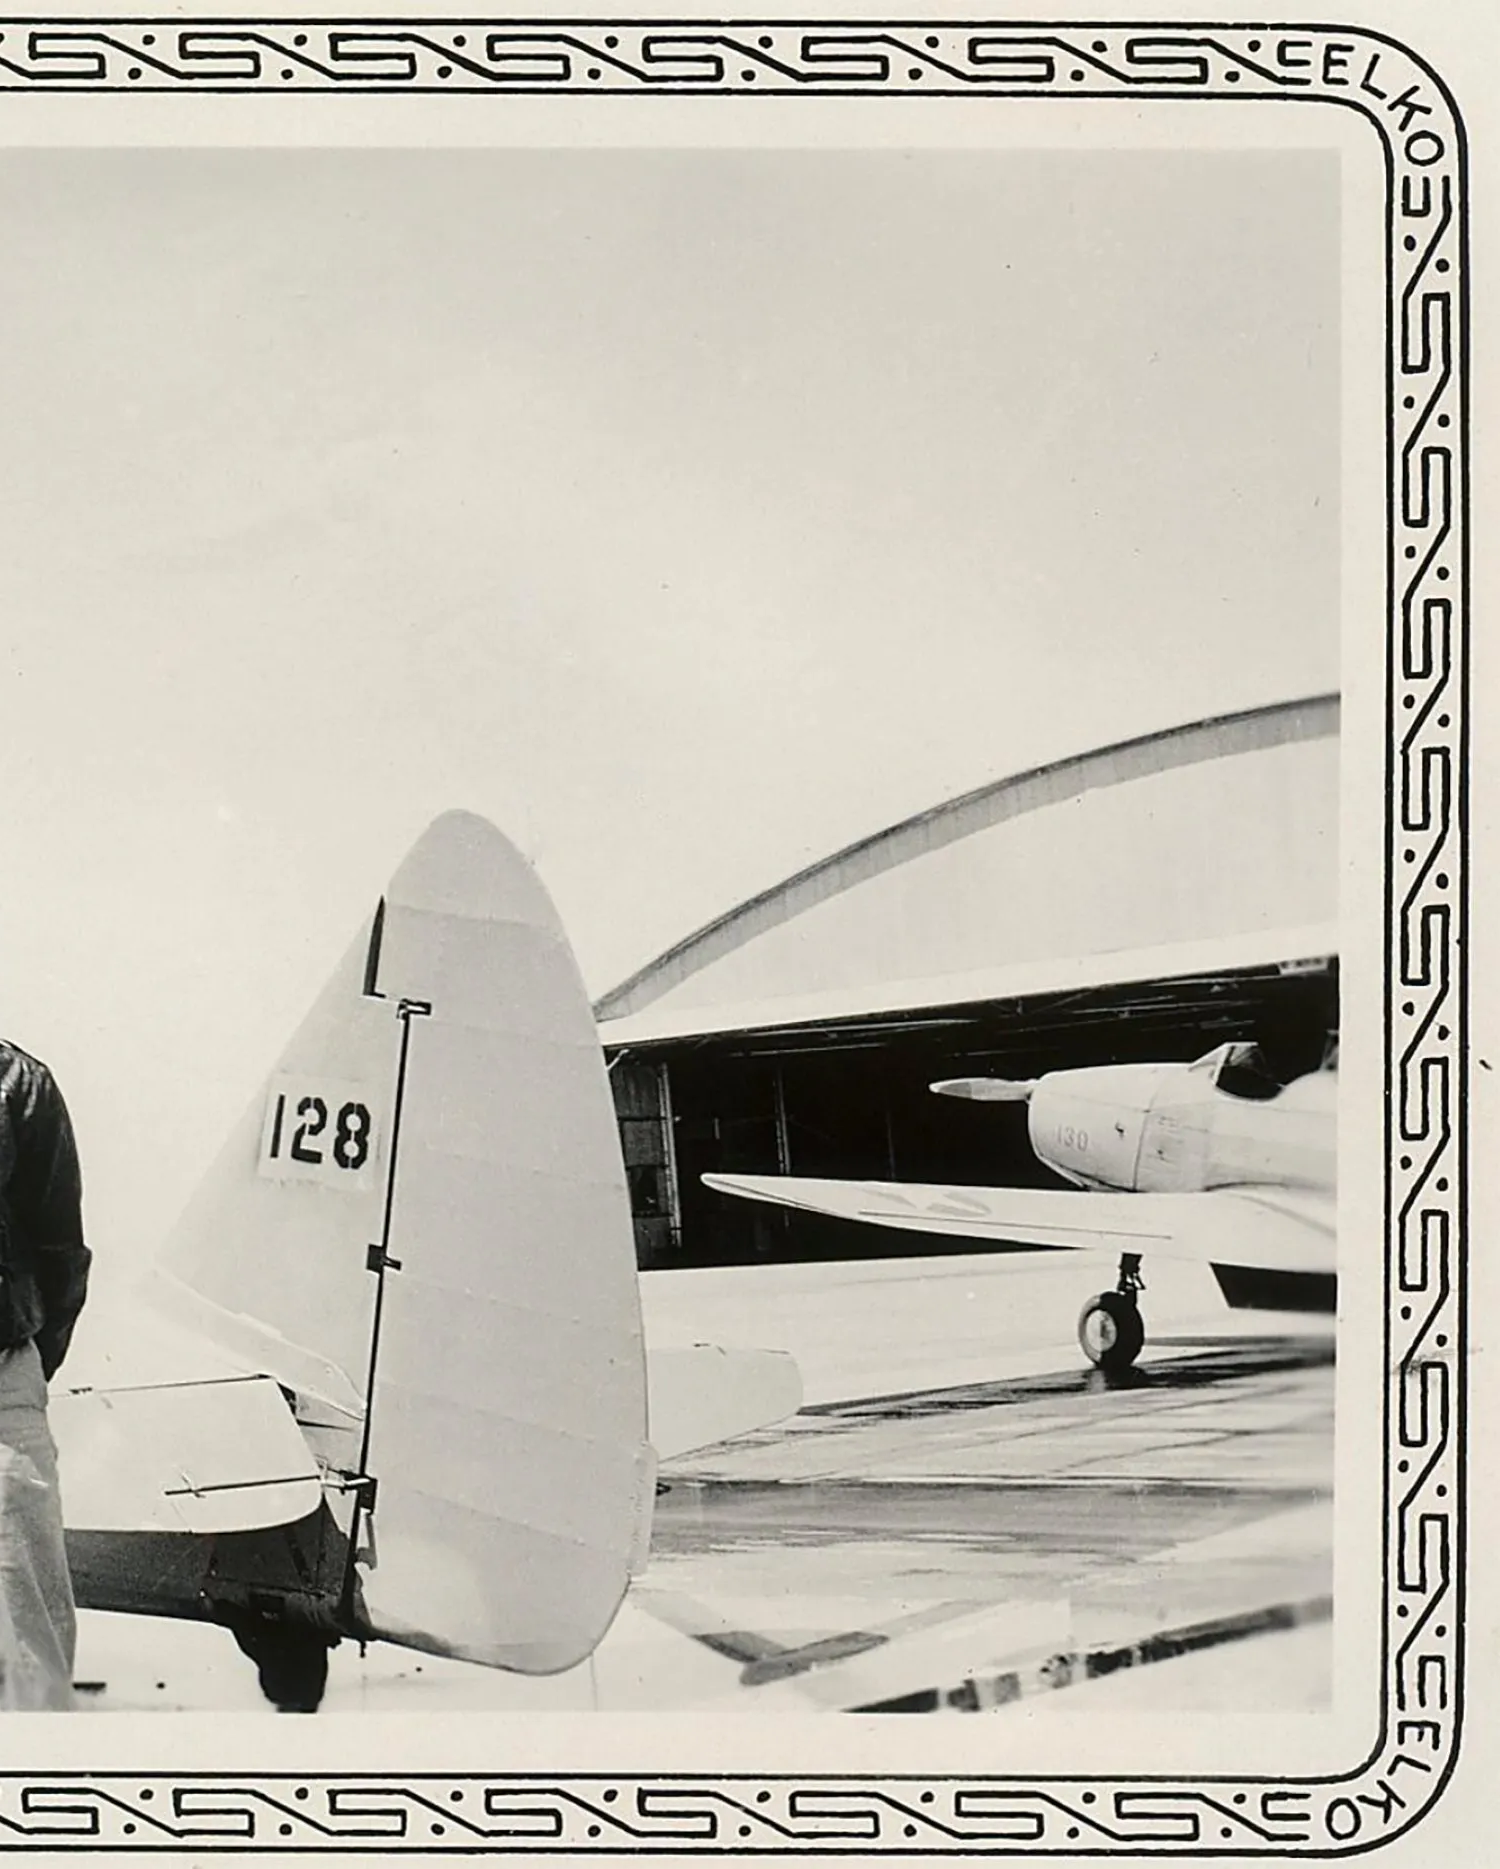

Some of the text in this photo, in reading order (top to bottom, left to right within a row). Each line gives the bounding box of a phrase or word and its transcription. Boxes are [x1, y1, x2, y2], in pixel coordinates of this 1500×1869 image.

[1321, 44, 1445, 167] ELKO
[270, 1093, 371, 1170] 128
[1324, 1719, 1440, 1840] ELKO
